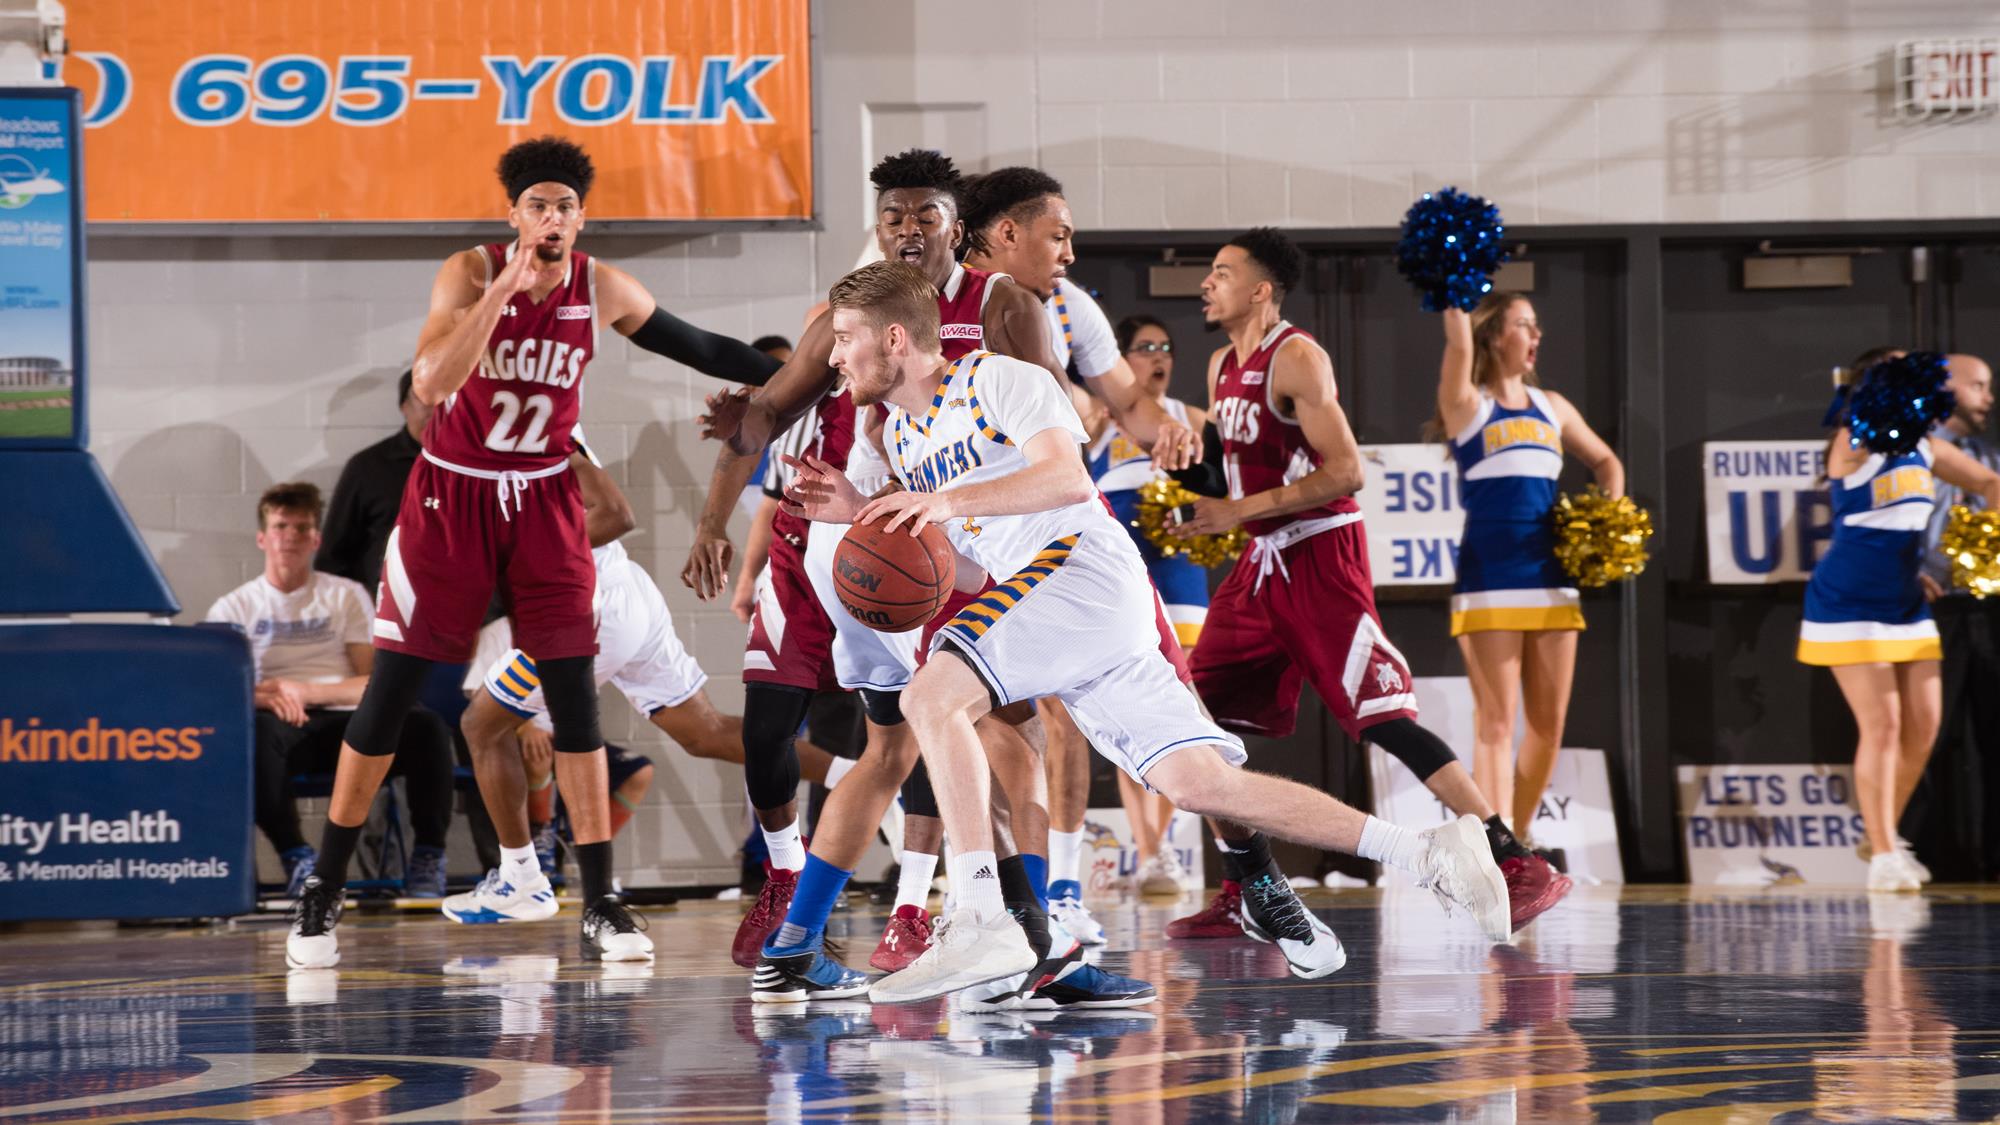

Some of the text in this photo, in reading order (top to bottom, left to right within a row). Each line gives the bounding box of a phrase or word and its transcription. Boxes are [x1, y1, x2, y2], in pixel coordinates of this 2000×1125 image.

[1926, 51, 1996, 99] EXIT
[0, 116, 60, 134] eadows
[478, 337, 586, 390] AGGIES
[484, 389, 553, 454] 22
[1713, 451, 1826, 478] RUNNER
[1703, 774, 1849, 806] LETS GO
[0, 810, 180, 855] ity Health
[1691, 814, 1867, 849] RUNNERS
[17, 858, 122, 882] Memorial
[127, 856, 229, 884] Hospitals
